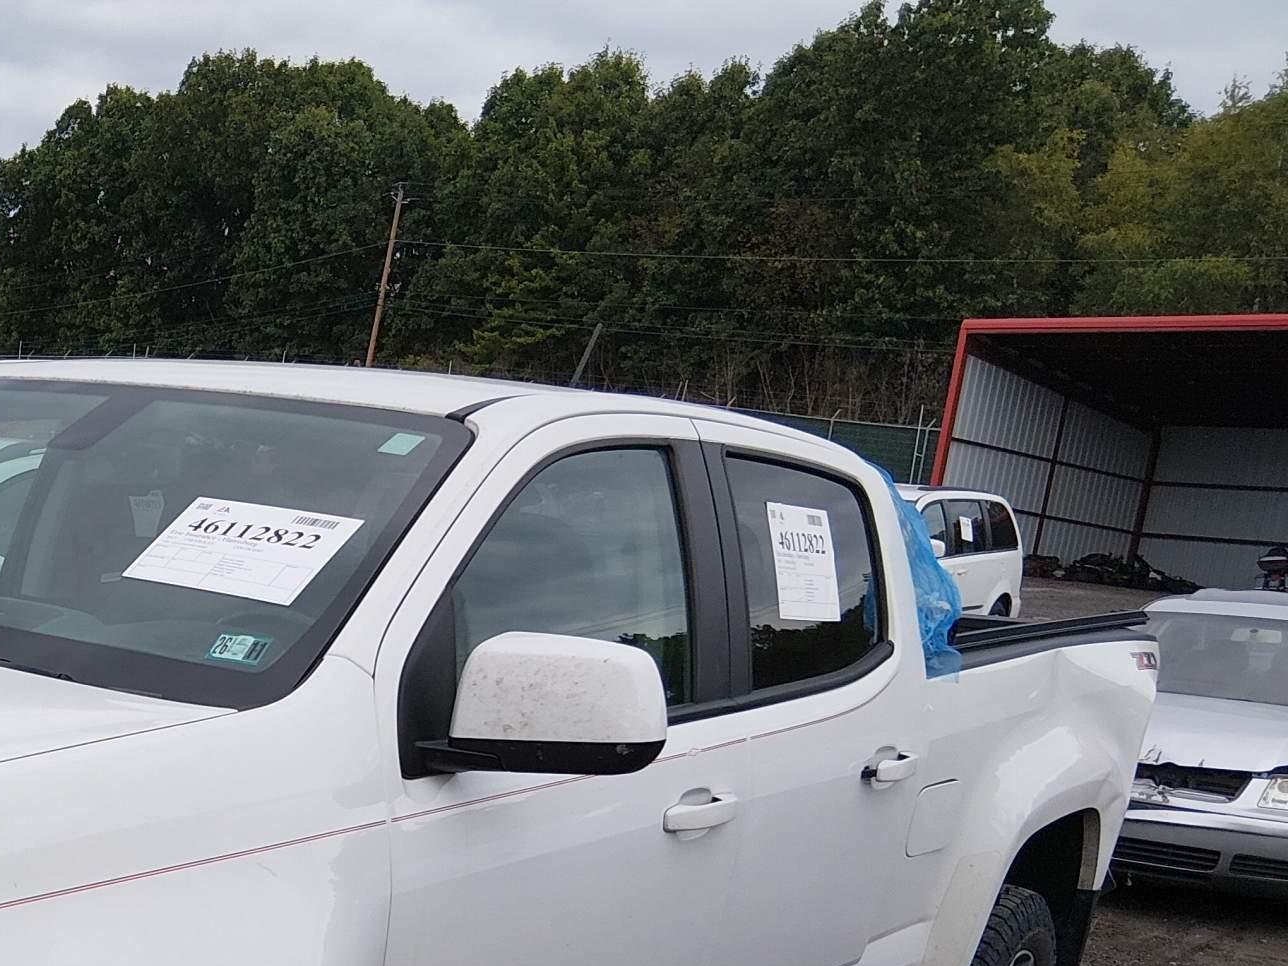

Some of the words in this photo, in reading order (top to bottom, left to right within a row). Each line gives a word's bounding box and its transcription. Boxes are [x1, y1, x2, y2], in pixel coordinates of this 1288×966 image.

[187, 517, 322, 550] 46112822
[778, 531, 827, 555] 46112822
[212, 636, 233, 655] 26
